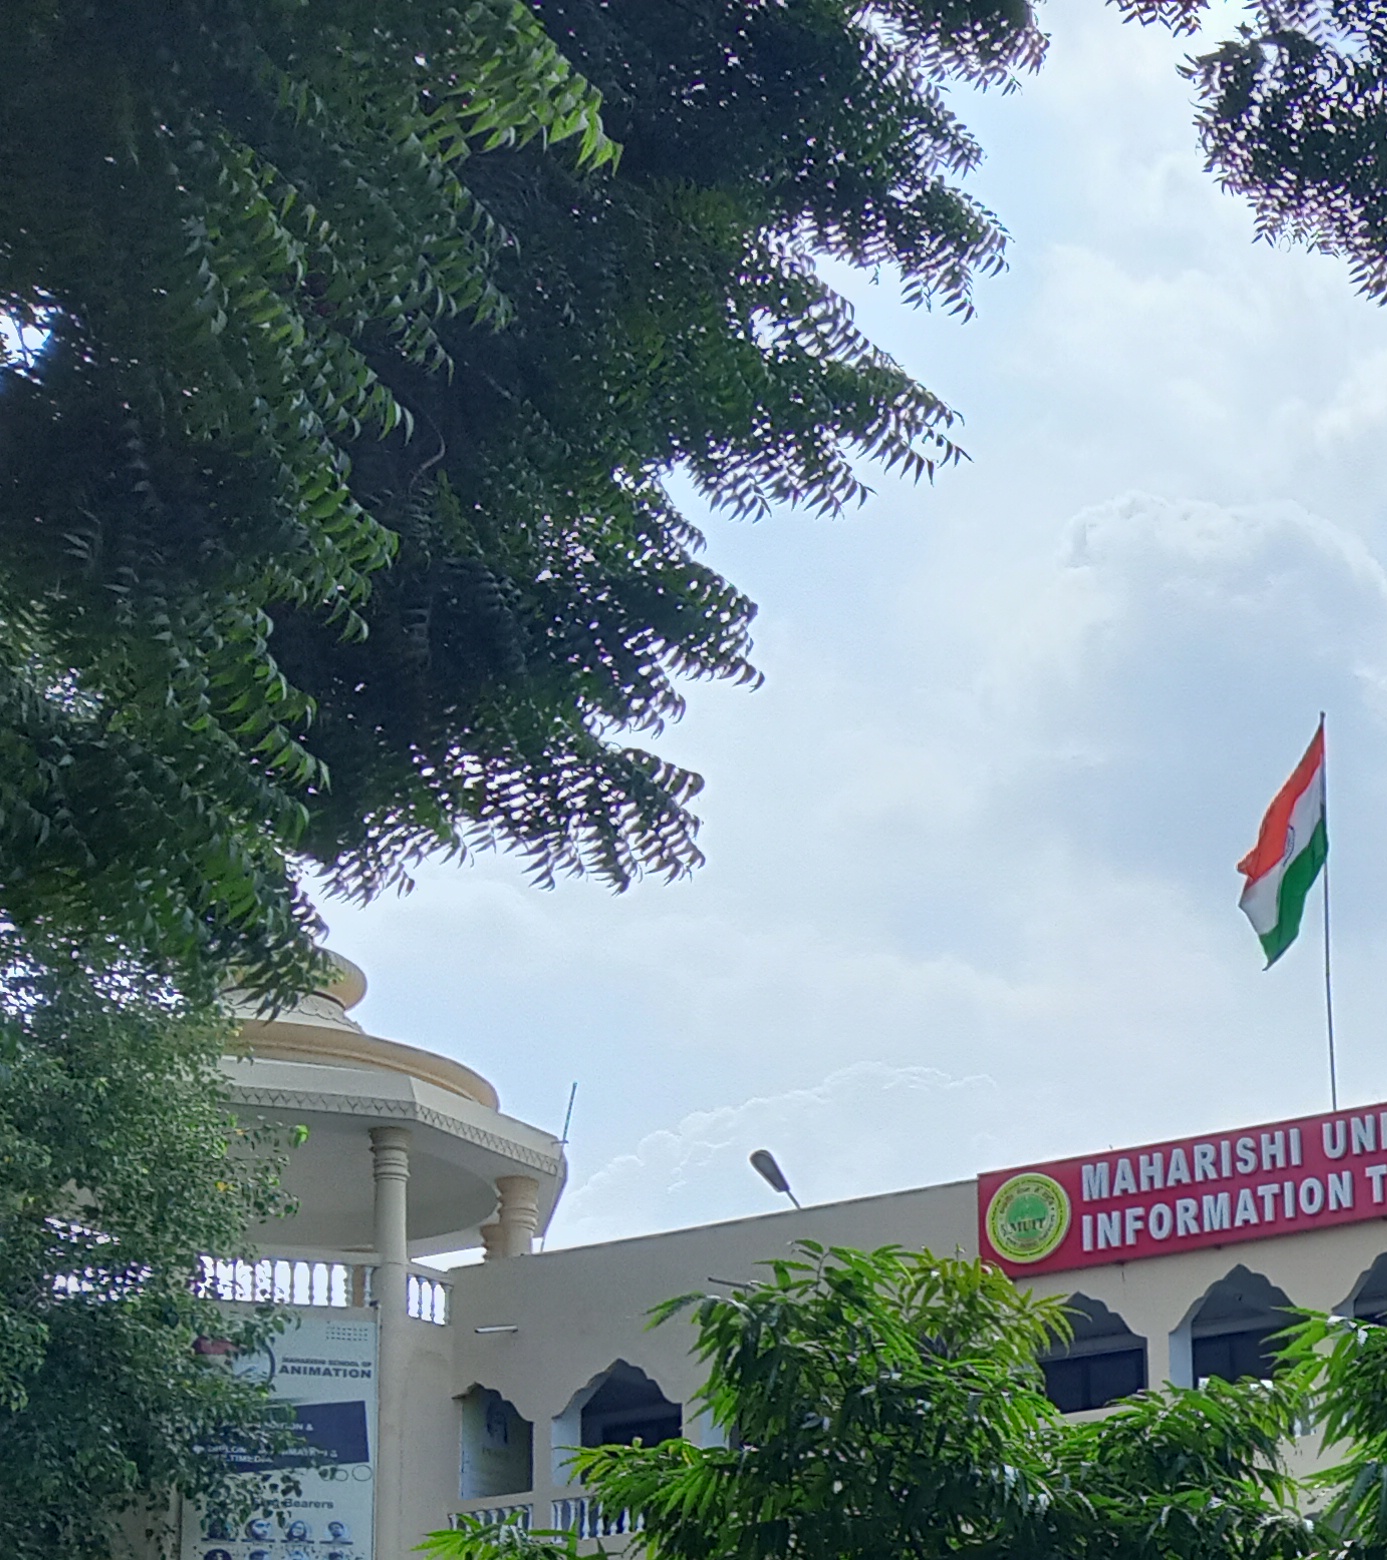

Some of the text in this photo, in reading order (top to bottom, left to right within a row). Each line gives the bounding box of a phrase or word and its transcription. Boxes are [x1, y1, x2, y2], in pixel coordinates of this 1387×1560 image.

[1081, 1127, 1303, 1202] MAHARISHI
[1082, 1170, 1355, 1253] INFORMATION
[1009, 1216, 1047, 1233] MUIT
[278, 1365, 372, 1378] ANIMATION
[284, 1499, 334, 1509] Bearers
